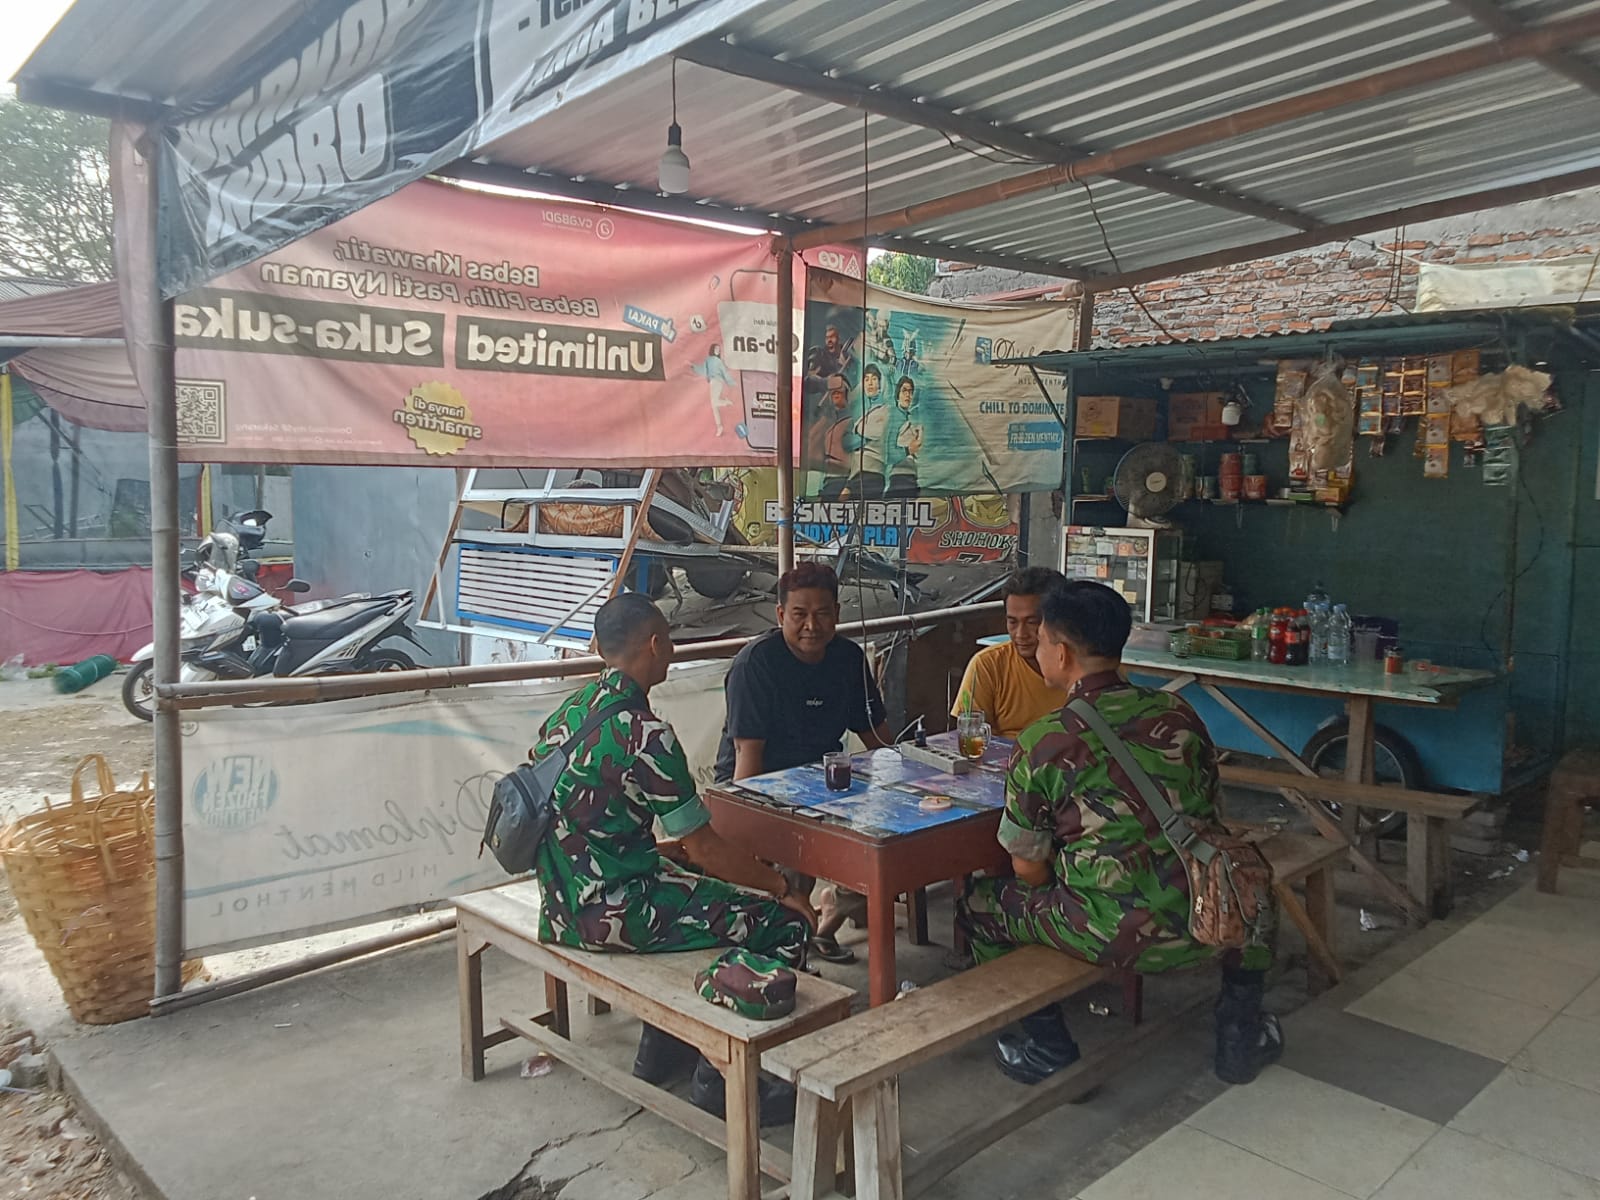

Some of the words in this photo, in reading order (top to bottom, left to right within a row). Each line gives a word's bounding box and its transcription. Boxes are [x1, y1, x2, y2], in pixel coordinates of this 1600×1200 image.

[979, 401, 1006, 415] CHILL
[1008, 401, 1020, 415] TO
[764, 500, 860, 525] BSKET
[866, 501, 937, 528] BALL
